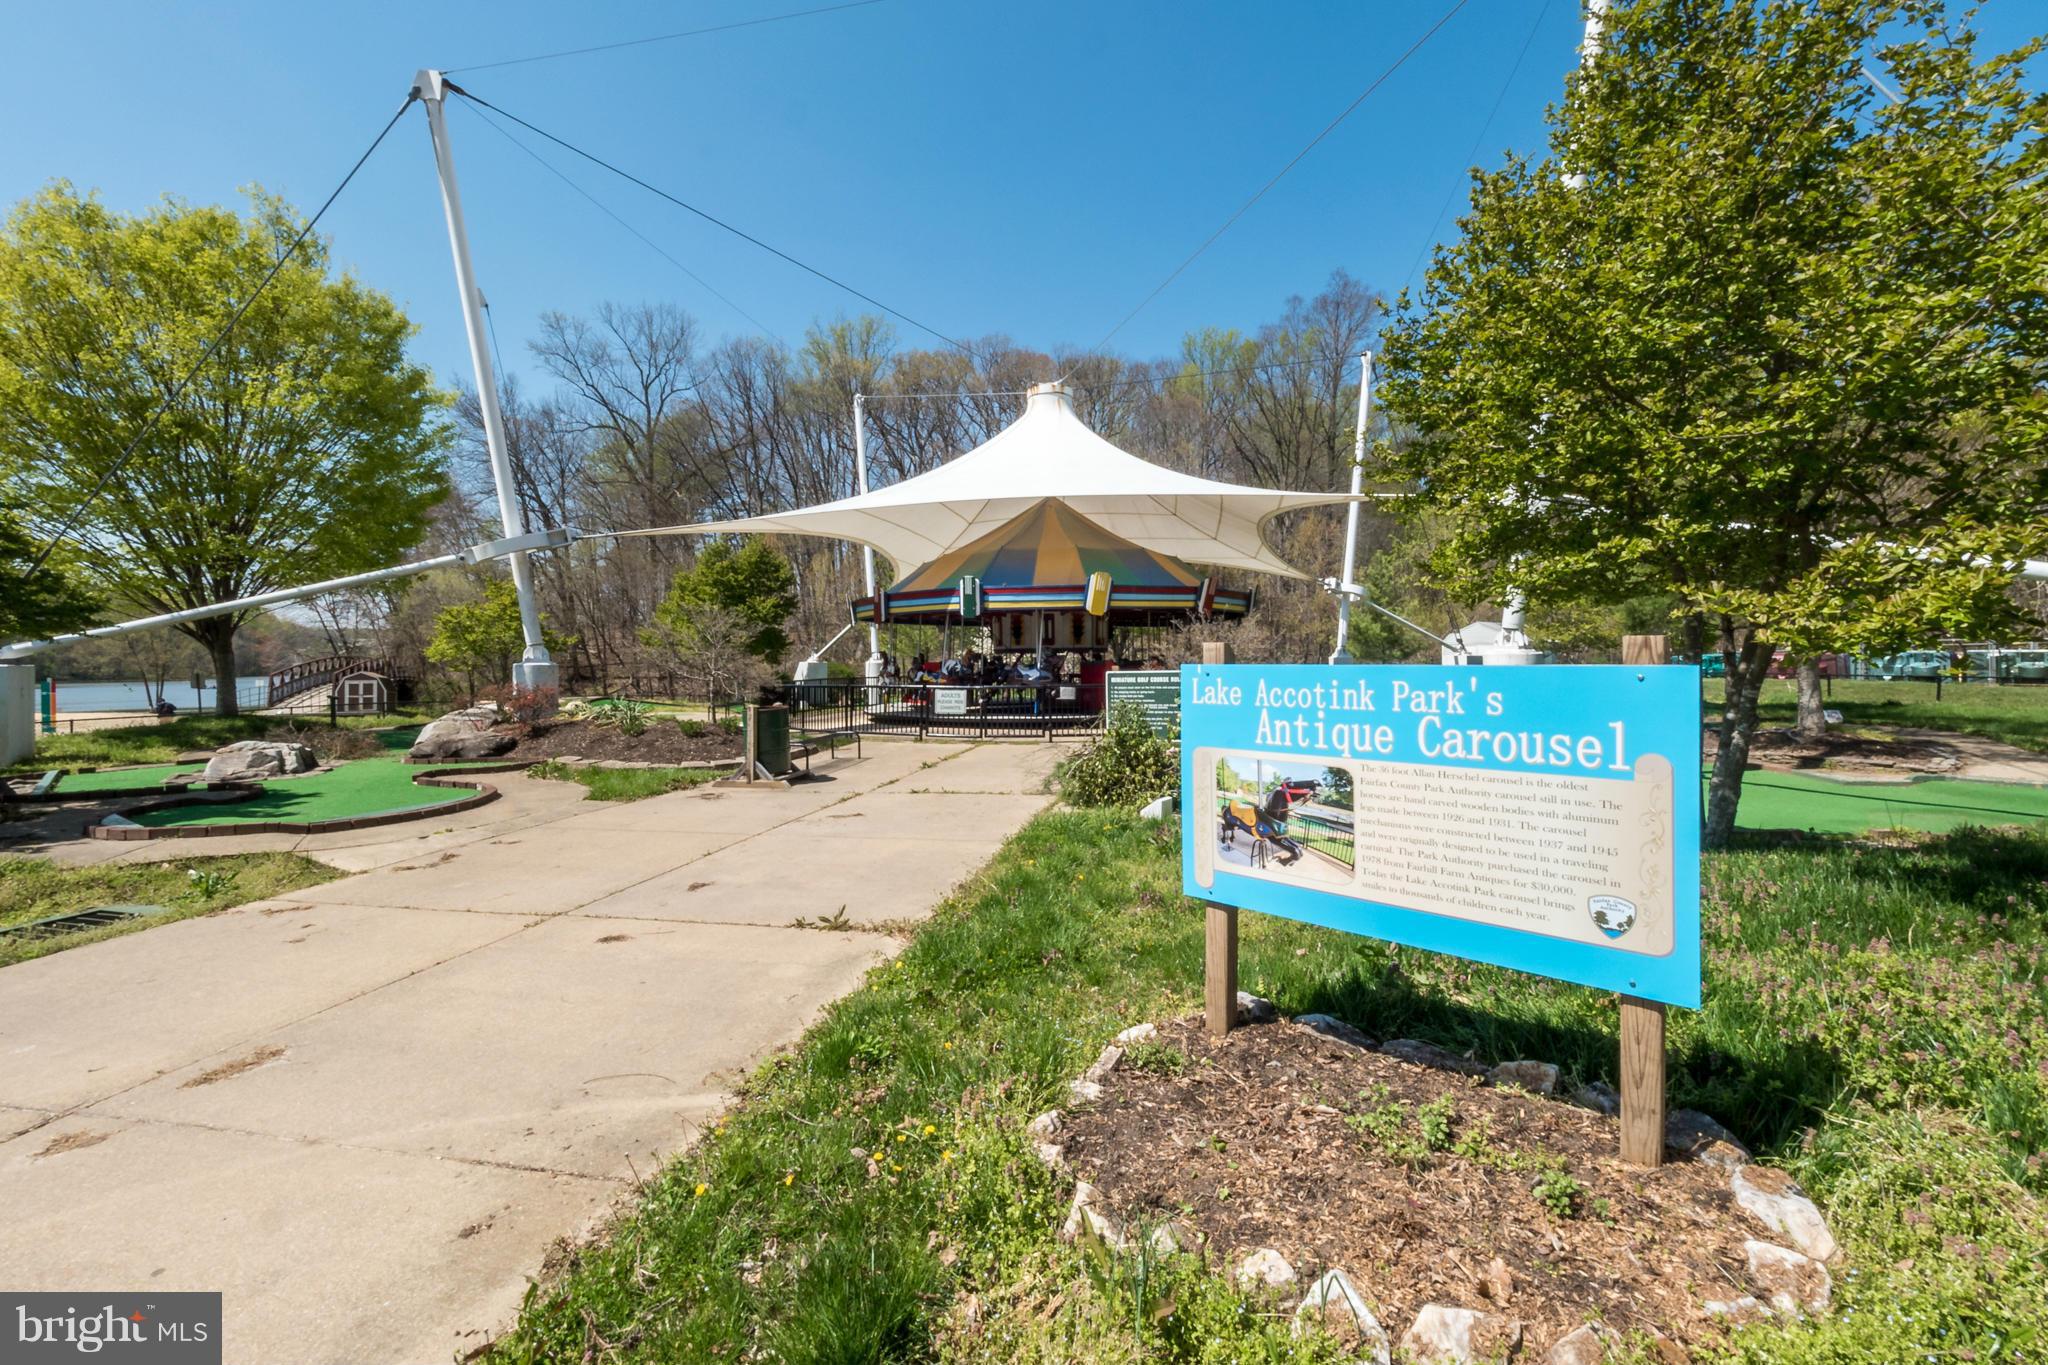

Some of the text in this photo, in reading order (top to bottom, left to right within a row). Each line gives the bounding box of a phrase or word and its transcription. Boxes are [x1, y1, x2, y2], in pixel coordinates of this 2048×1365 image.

[1192, 676, 1504, 716] Lake Accotink Park's
[1255, 708, 1632, 771] Antique Carousel
[1360, 764, 1377, 773] The
[1391, 766, 1409, 776] foot
[1412, 768, 1435, 779] Allan
[1438, 770, 1480, 782] Herschel
[1482, 775, 1523, 786] carousel
[1526, 778, 1534, 787] is
[1537, 779, 1553, 789] the
[1556, 780, 1588, 792] oldest
[1360, 777, 1623, 811] Fairfax County Park Authority carousel still in use. The
[1360, 790, 1386, 800] horses
[1404, 795, 1426, 805] hand
[1428, 798, 1458, 808] carved
[1460, 801, 1499, 812] wooden
[1502, 805, 1534, 816] bodies
[1537, 809, 1560, 819] with
[1562, 811, 1619, 826] aluminum
[1360, 803, 1375, 812] legs
[1377, 805, 1400, 815] made
[1403, 807, 1439, 820] between
[1467, 815, 1485, 825] and
[1519, 820, 1539, 831] The
[1542, 825, 1587, 838] carousel
[1360, 818, 1412, 830] mechanisms
[1437, 828, 1490, 840] constructed
[1493, 833, 1534, 846] between
[1539, 839, 1563, 849] 1937
[1567, 844, 1587, 853] and
[1592, 845, 1619, 857] 1945
[1360, 830, 1376, 838] and
[1400, 836, 1439, 847] originally
[1442, 841, 1483, 854] designed
[1485, 847, 1496, 855] to
[1498, 848, 1510, 857] be
[1513, 852, 1537, 861] used
[1540, 854, 1550, 863] in
[1562, 858, 1609, 873] traveling
[1383, 858, 1404, 869] from
[1407, 861, 1438, 874] Fairhill
[1440, 867, 1465, 878] Farm
[1468, 872, 1510, 886] Antiques
[1513, 880, 1527, 888] for
[1398, 847, 1414, 857] The
[1418, 850, 1438, 861] Park
[1441, 854, 1484, 868] Authority
[1487, 862, 1538, 876] purchased
[1542, 869, 1558, 879] the
[1561, 873, 1607, 888] carousel
[1610, 880, 1621, 888] in
[1362, 867, 1576, 912] Today the Lake Accotink Park carousel brings
[1362, 882, 1387, 892] smiles
[1400, 887, 1444, 902] thousands
[1446, 895, 1456, 904] of
[1457, 897, 1497, 912] children
[1500, 905, 1524, 916] each
